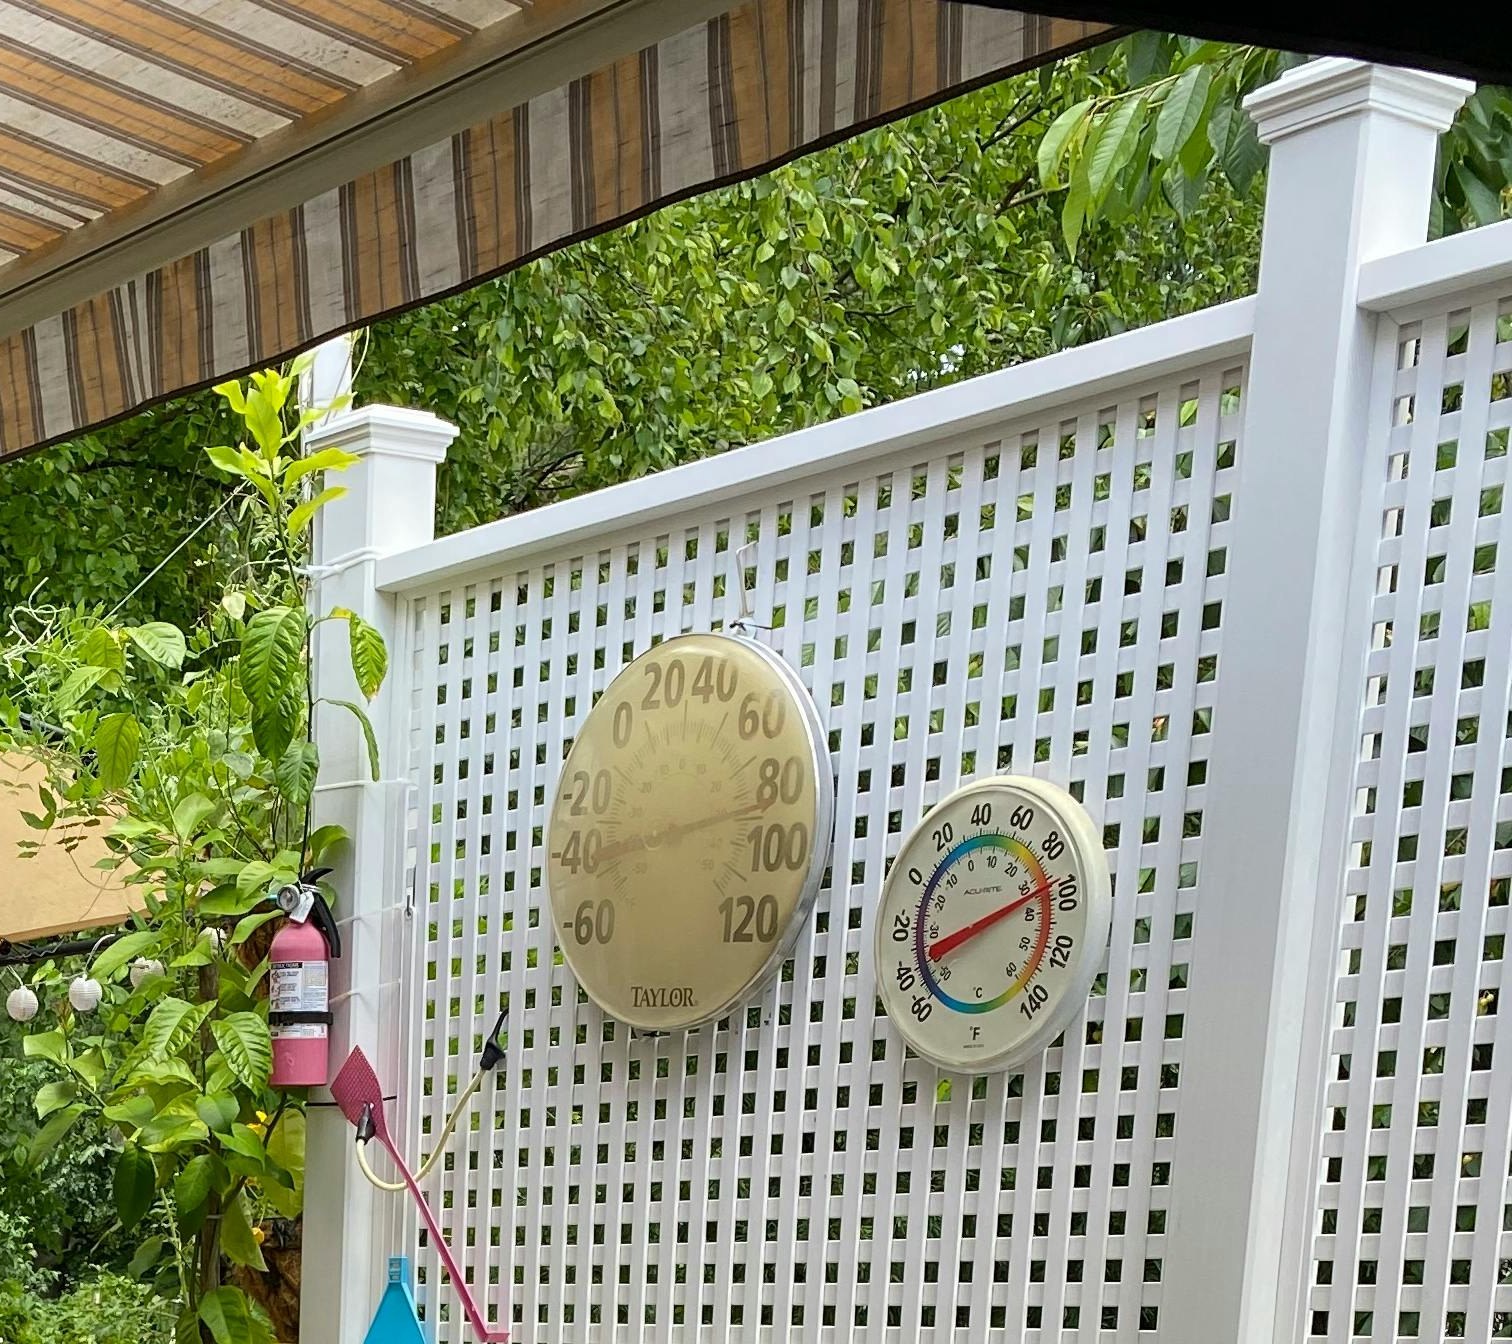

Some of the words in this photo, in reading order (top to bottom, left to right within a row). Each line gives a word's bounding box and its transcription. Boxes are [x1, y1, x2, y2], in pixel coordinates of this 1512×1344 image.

[641, 659, 685, 711] 20
[691, 656, 738, 704] 40
[613, 701, 633, 749] 0
[738, 688, 786, 741] 60
[563, 769, 611, 816] -20
[756, 756, 805, 806] 80
[971, 803, 992, 826] 40
[1010, 805, 1034, 831] 60
[551, 829, 602, 874] -40
[747, 822, 808, 872] 100
[932, 823, 953, 852] 20
[1042, 831, 1065, 861] 80
[908, 868, 923, 885] 0
[968, 860, 975, 871] 0
[988, 856, 997, 868] 10
[1004, 863, 1018, 878] 20
[1018, 880, 1030, 896] 30
[1058, 874, 1078, 912] 100
[563, 899, 616, 945] -60
[718, 894, 779, 943] 120
[892, 909, 911, 942] -20
[1024, 907, 1035, 922] 40
[1019, 936, 1031, 951] 50
[1049, 935, 1074, 970] 120
[896, 960, 915, 992] -40
[1006, 961, 1017, 977] 60
[631, 986, 694, 1008] TAYLOR
[911, 994, 933, 1023] -60
[1020, 984, 1049, 1021] 140
